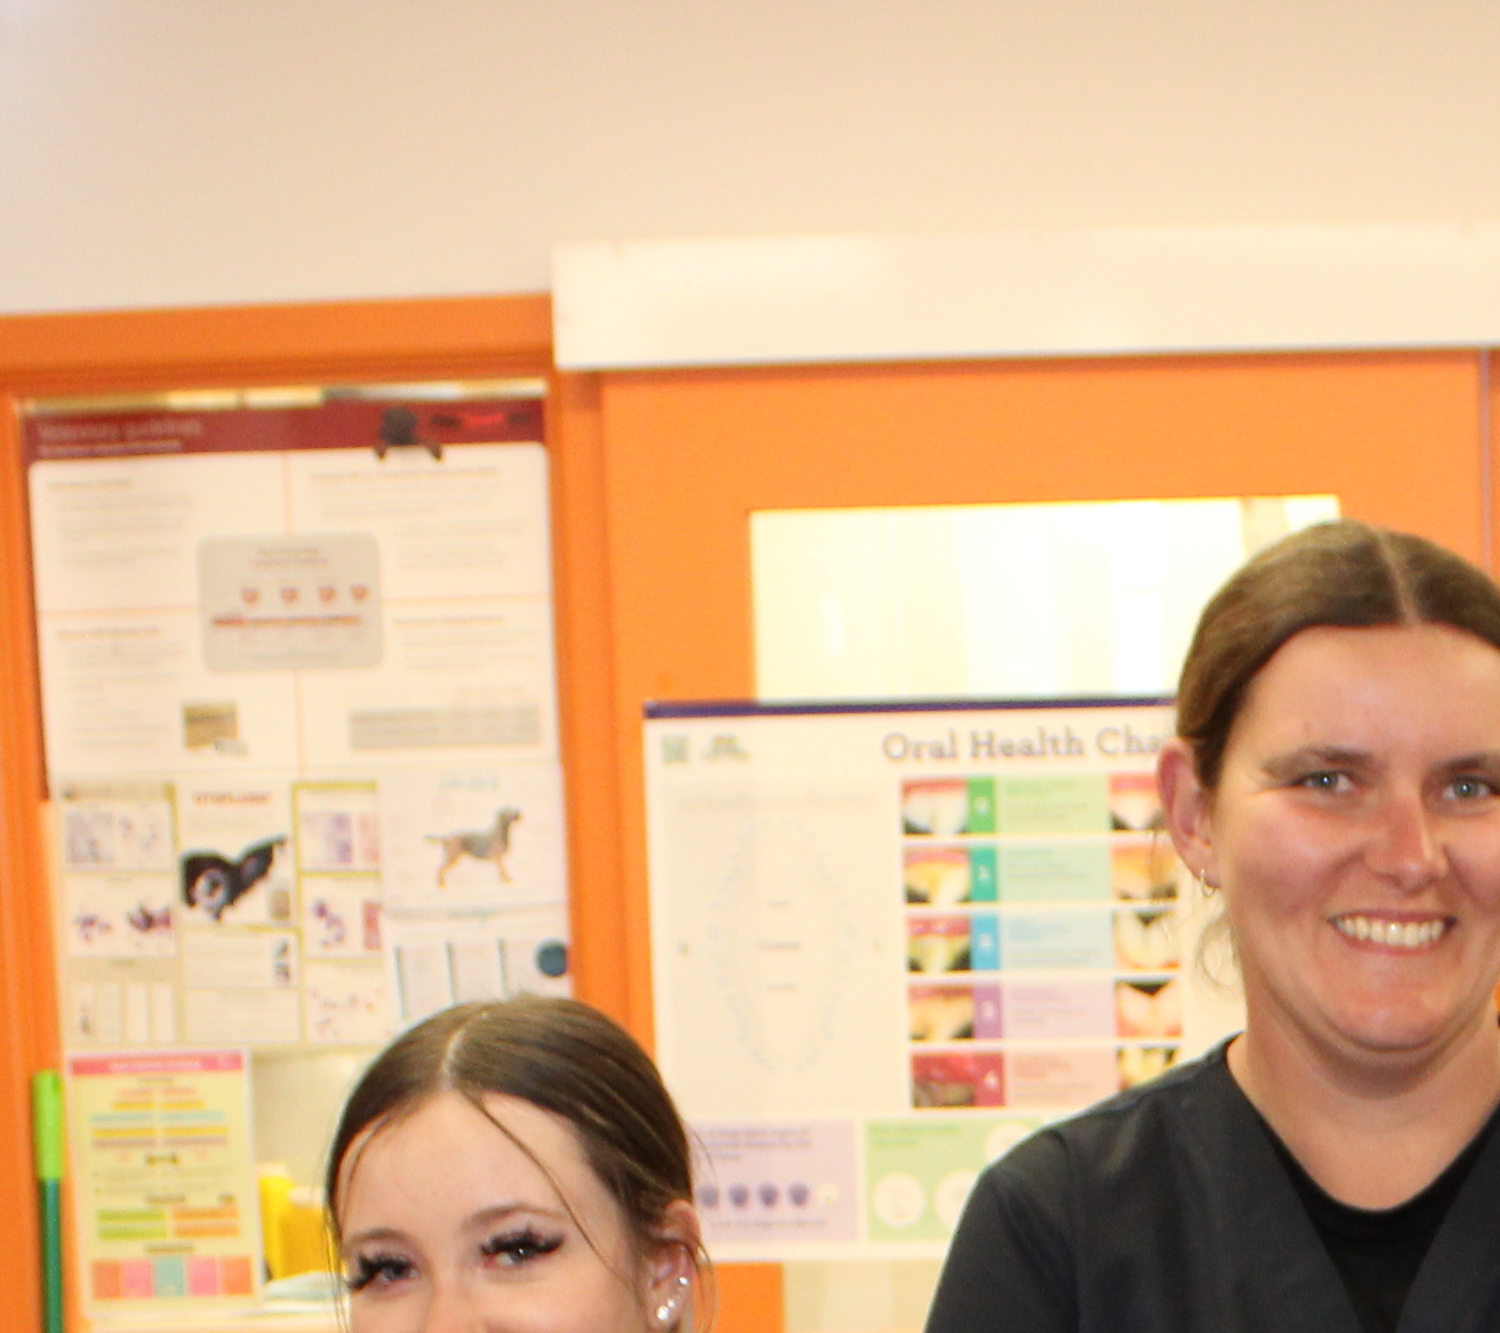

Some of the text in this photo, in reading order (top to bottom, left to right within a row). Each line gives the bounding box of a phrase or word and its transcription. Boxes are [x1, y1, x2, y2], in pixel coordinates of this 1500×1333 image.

[882, 722, 1168, 759] Oral Health Cha
